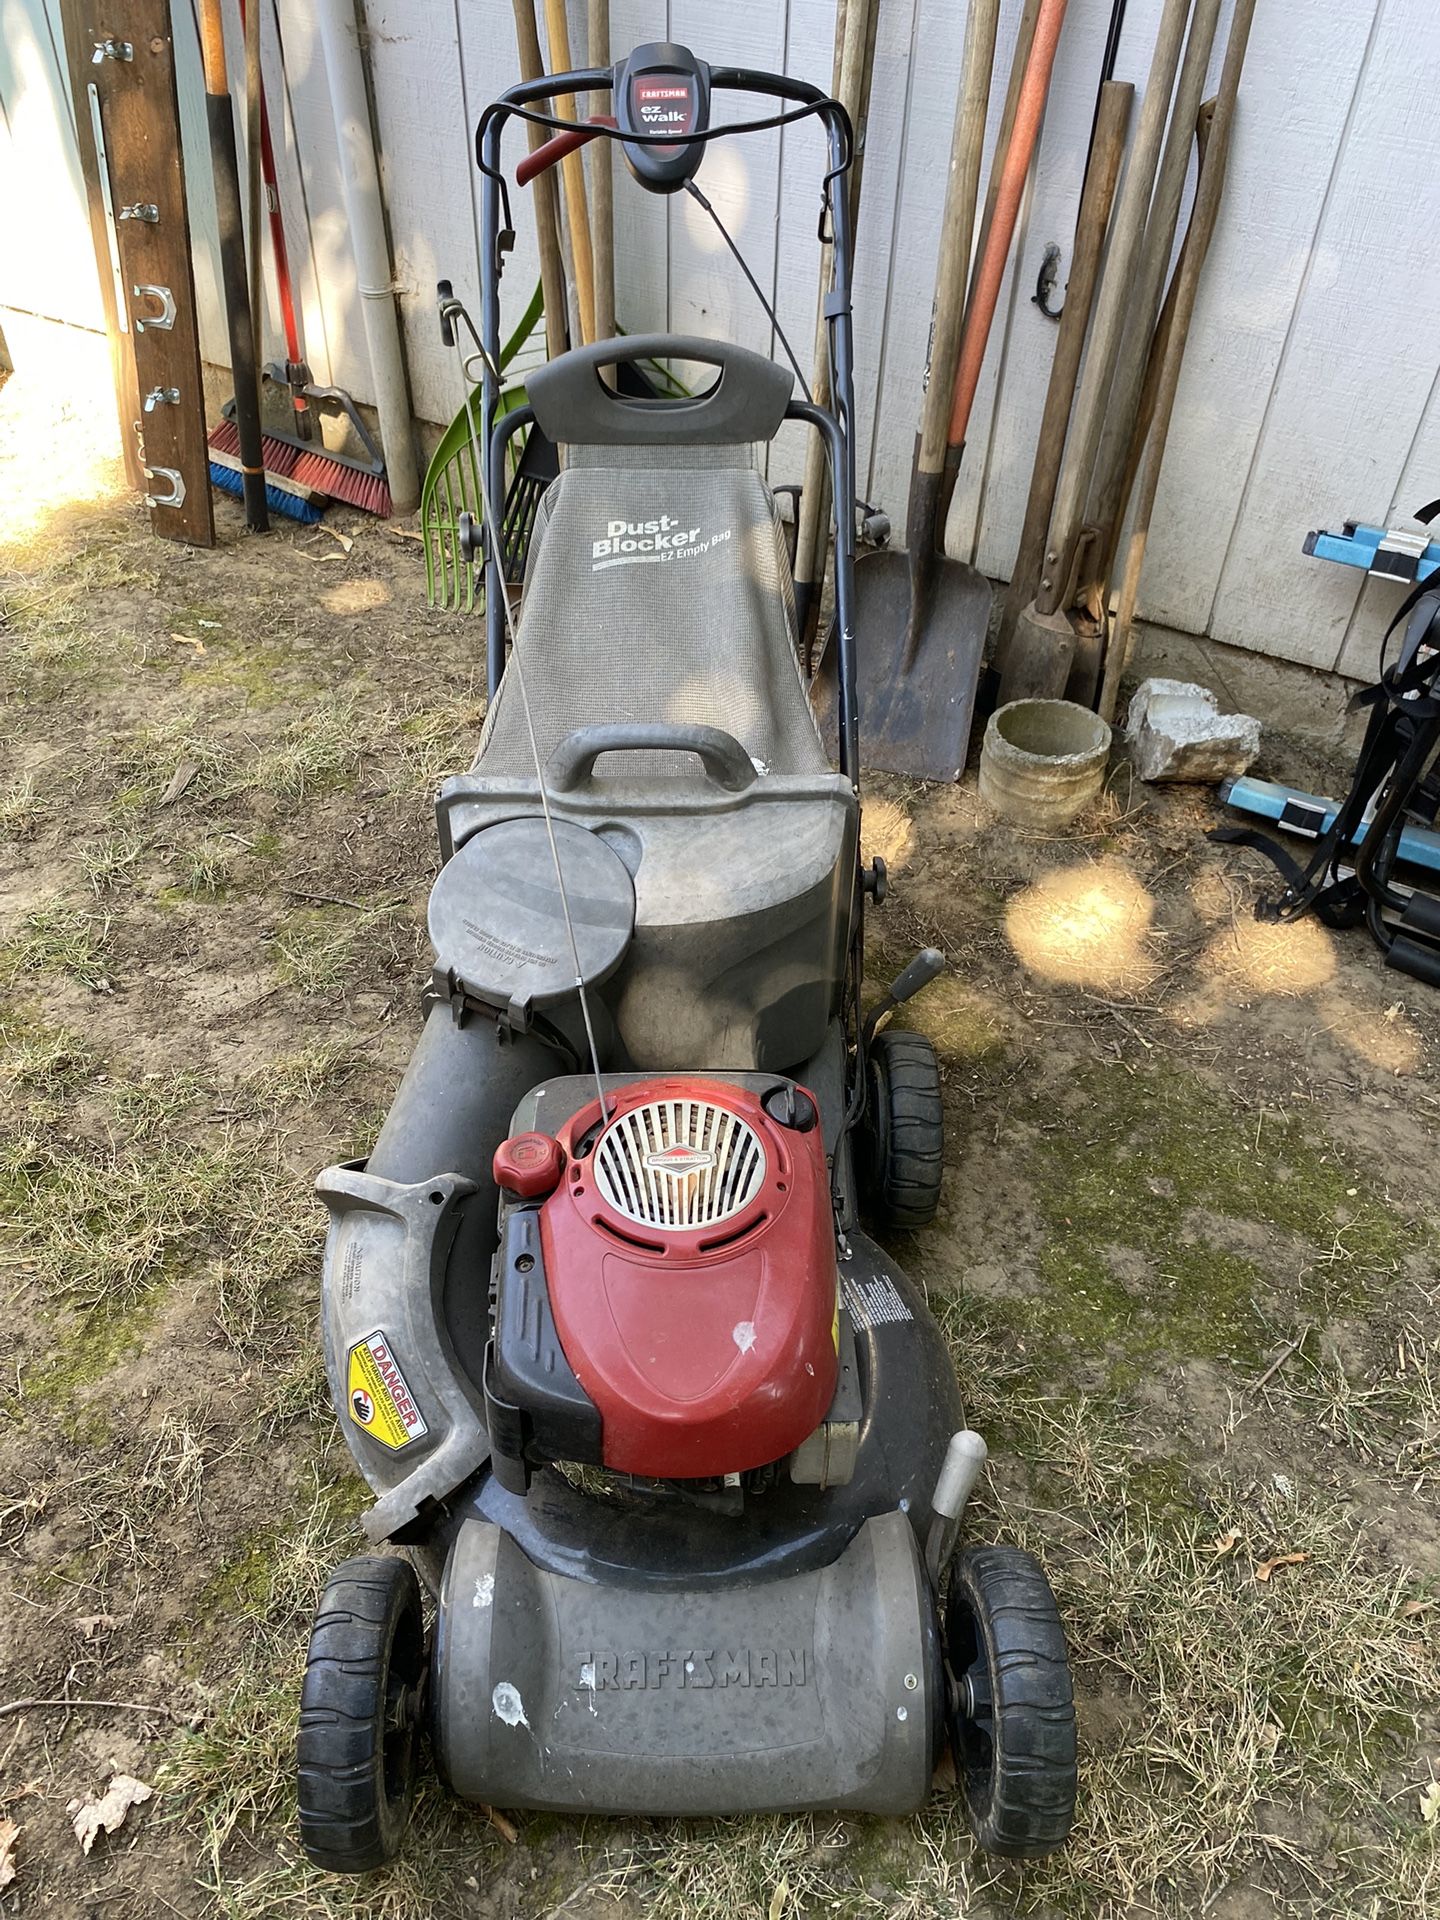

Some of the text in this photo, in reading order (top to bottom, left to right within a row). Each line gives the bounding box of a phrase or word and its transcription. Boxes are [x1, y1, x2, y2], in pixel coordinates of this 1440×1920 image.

[640, 105, 662, 114] ez
[641, 111, 686, 122] walk
[607, 514, 679, 538] Dust-
[592, 527, 701, 558] Blocker
[660, 529, 731, 561] EZ Empty Bag
[361, 1347, 407, 1438] KEEP HANDS AND FEET AWAY
[370, 1344, 419, 1428] DANGER
[573, 1650, 806, 1691] CRAFTSMAN
